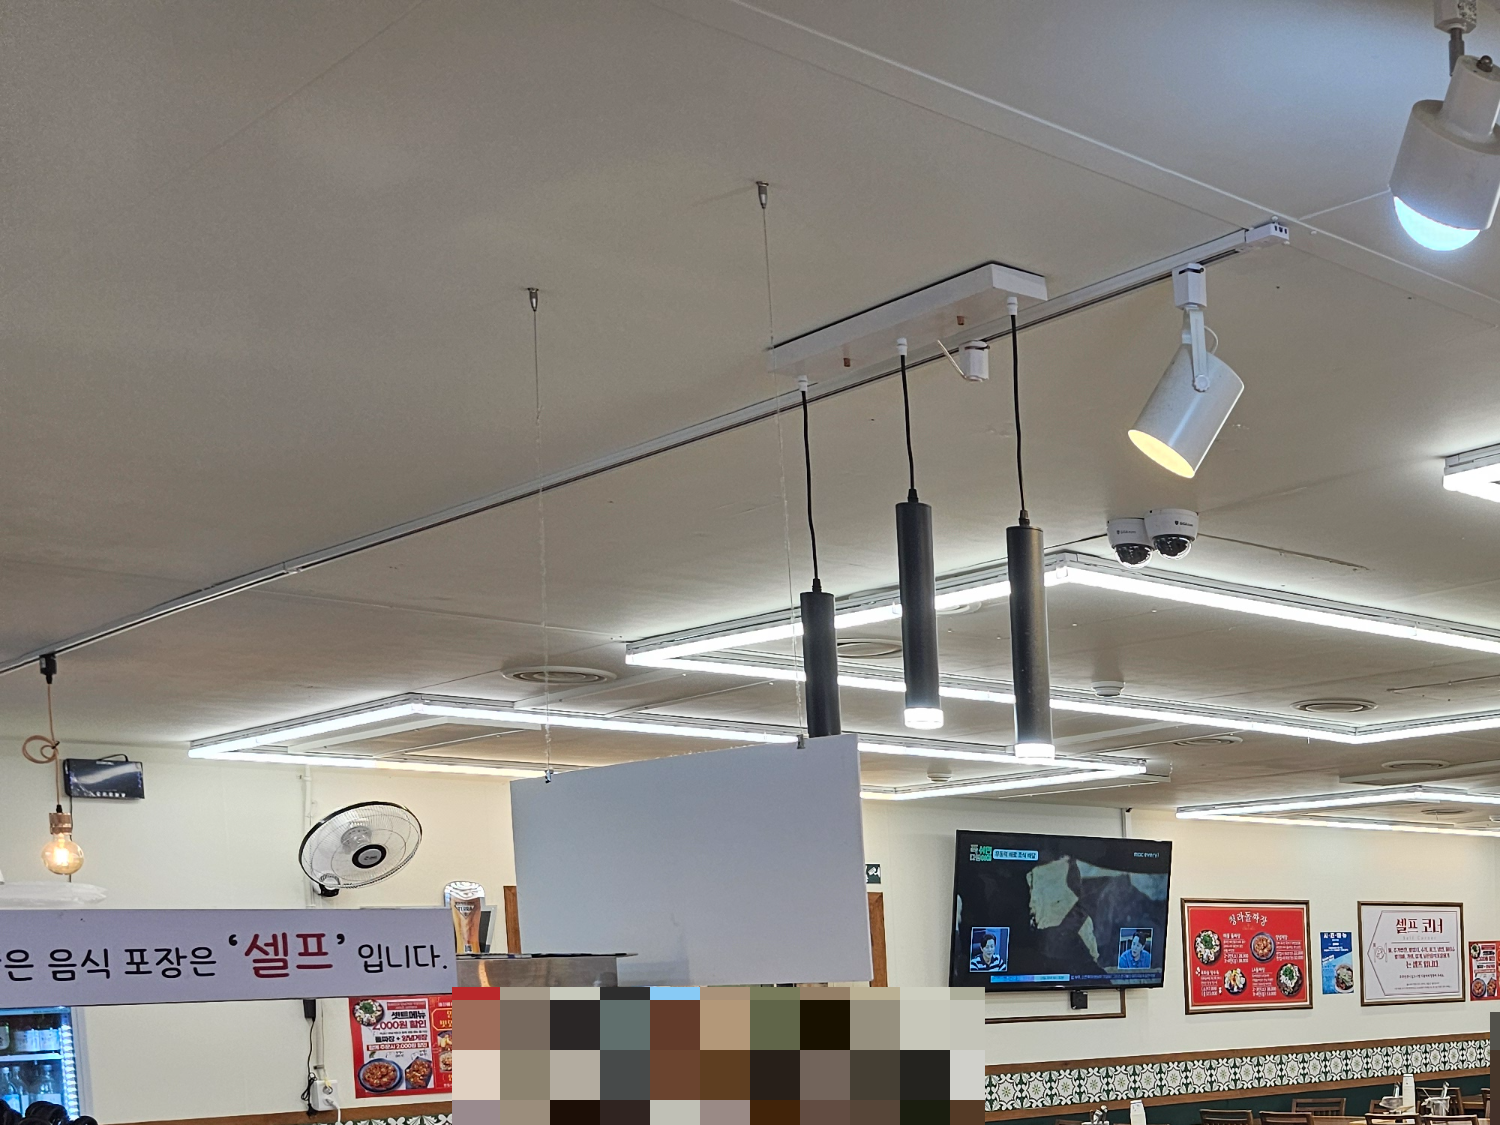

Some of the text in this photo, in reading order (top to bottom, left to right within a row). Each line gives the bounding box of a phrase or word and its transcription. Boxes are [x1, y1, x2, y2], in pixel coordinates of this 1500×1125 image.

[1396, 918, 1443, 934] 셀프 코너
[0, 947, 34, 982] 은
[48, 948, 111, 982] 음식
[124, 946, 217, 978] 포장은
[358, 942, 448, 973] 입니다.
